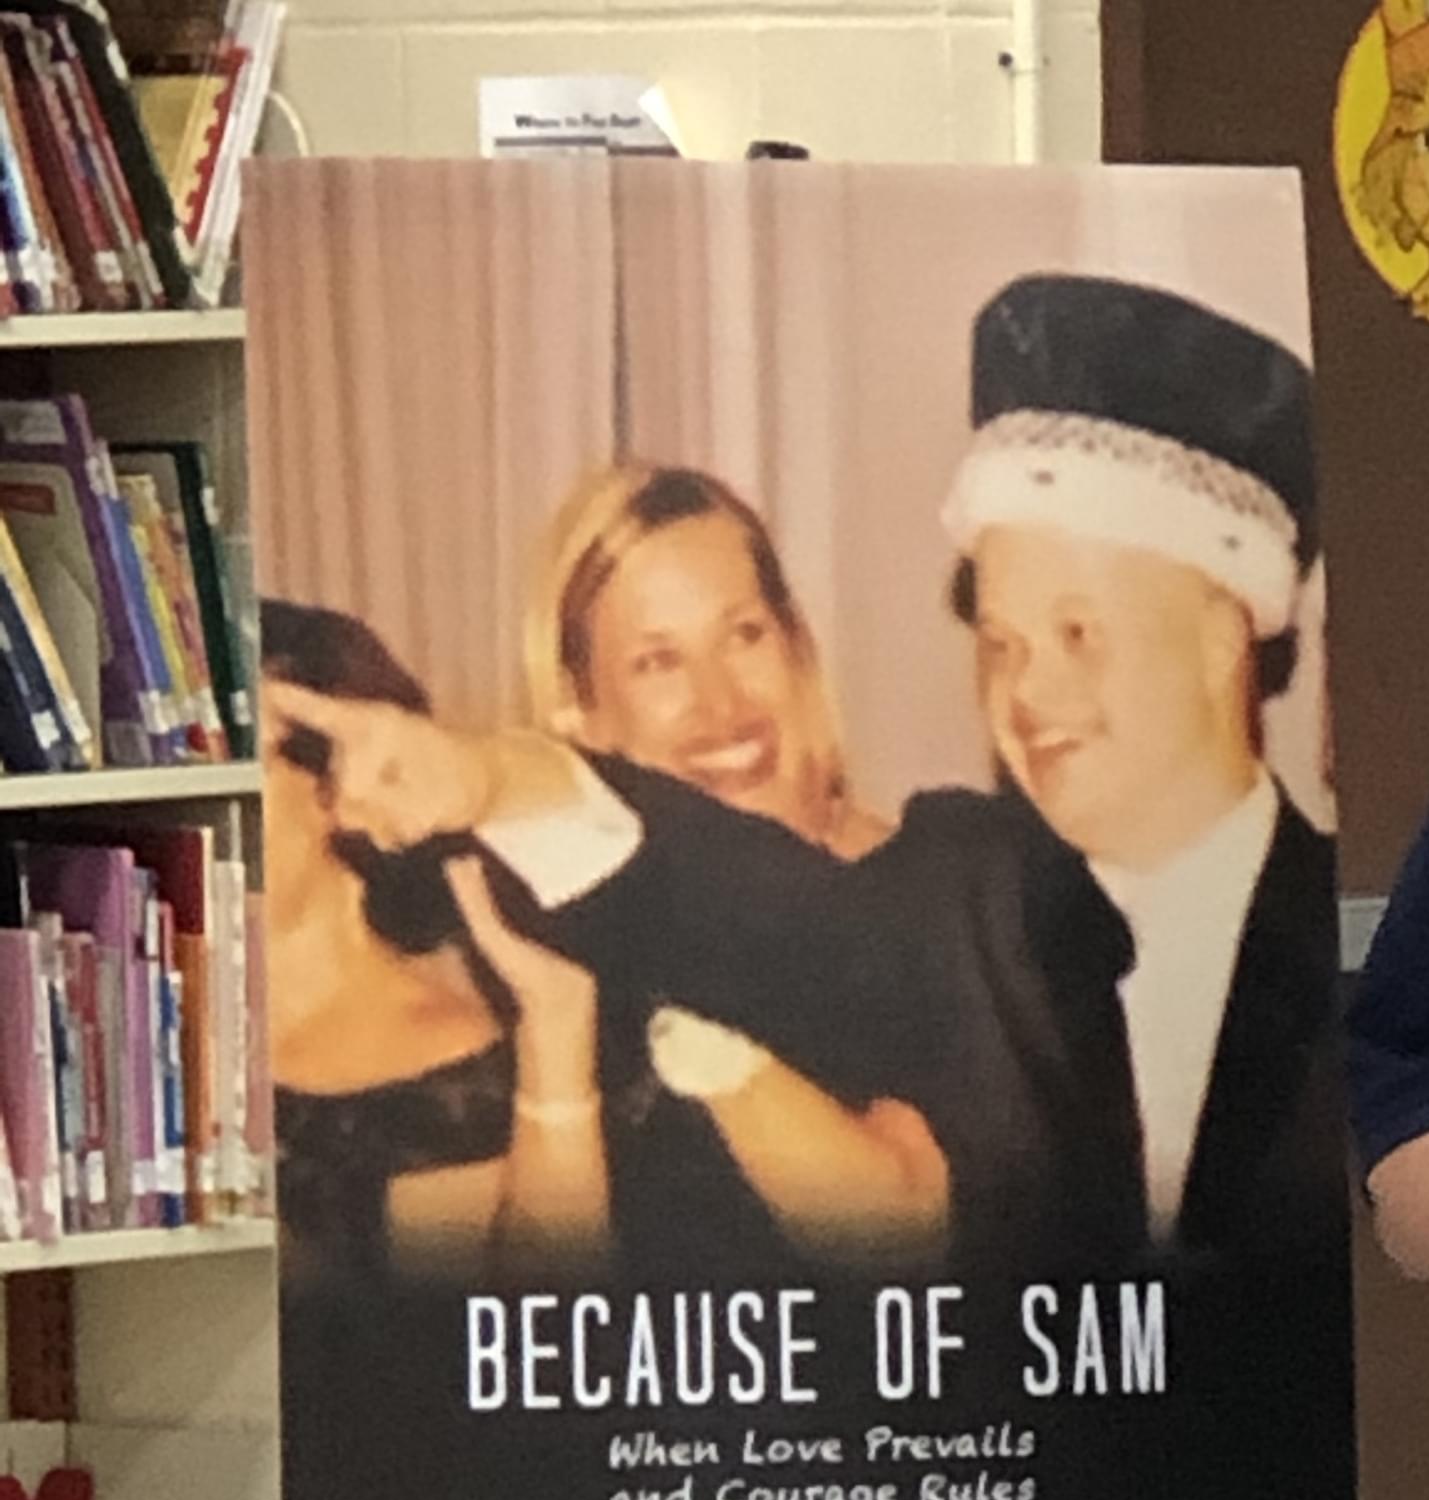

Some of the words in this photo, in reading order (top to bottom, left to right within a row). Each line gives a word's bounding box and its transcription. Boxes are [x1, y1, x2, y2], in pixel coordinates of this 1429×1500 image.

[467, 1290, 818, 1411] BECAUSE
[875, 1286, 964, 1399] OF
[1021, 1282, 1168, 1396] SAM
[609, 1432, 720, 1468] When
[743, 1429, 843, 1464] Love
[865, 1422, 1035, 1461] Prevails
